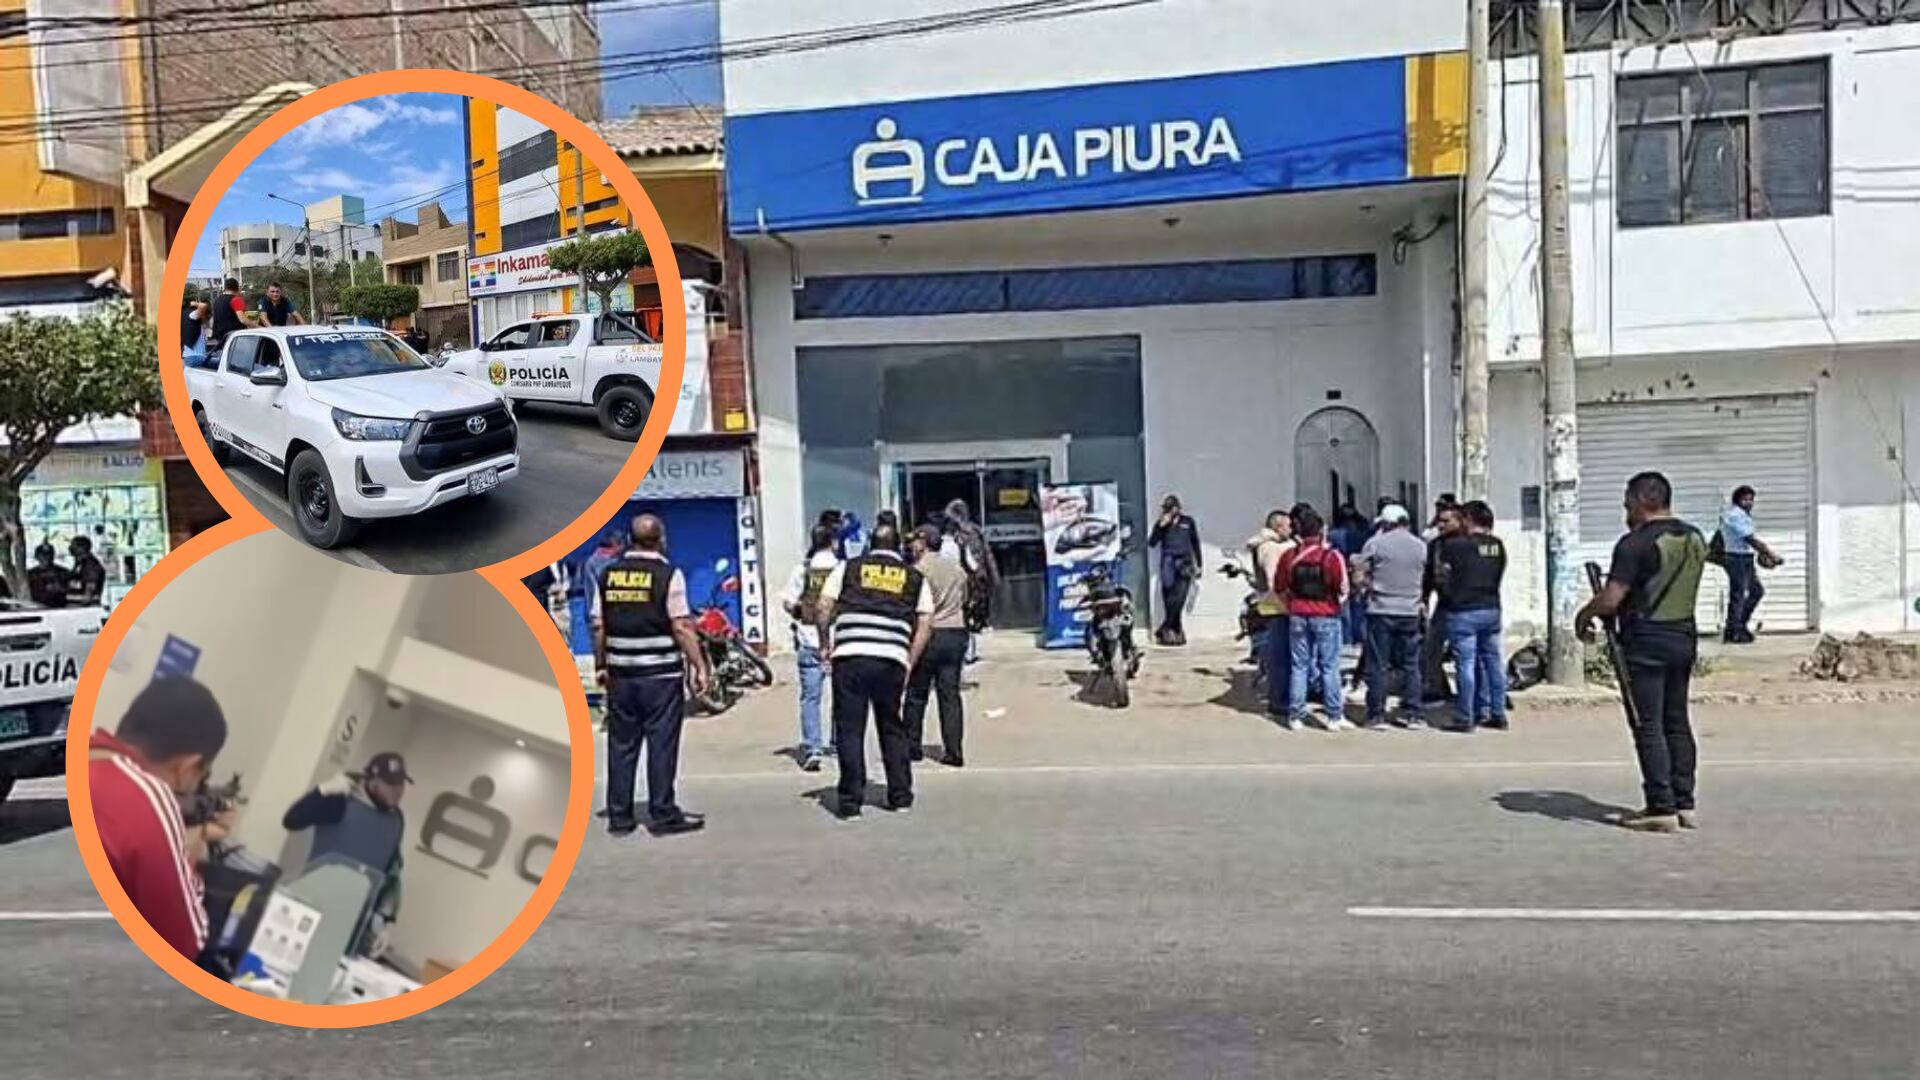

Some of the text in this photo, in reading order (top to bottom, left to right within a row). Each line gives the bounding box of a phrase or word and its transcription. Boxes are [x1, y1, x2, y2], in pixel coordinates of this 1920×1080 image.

[934, 117, 1242, 186] CAJA PIURA
[497, 252, 552, 275] Inkama
[630, 355, 662, 363] LAMBAY
[509, 364, 570, 380] POLICÍA
[0, 652, 78, 688] LICÍA
